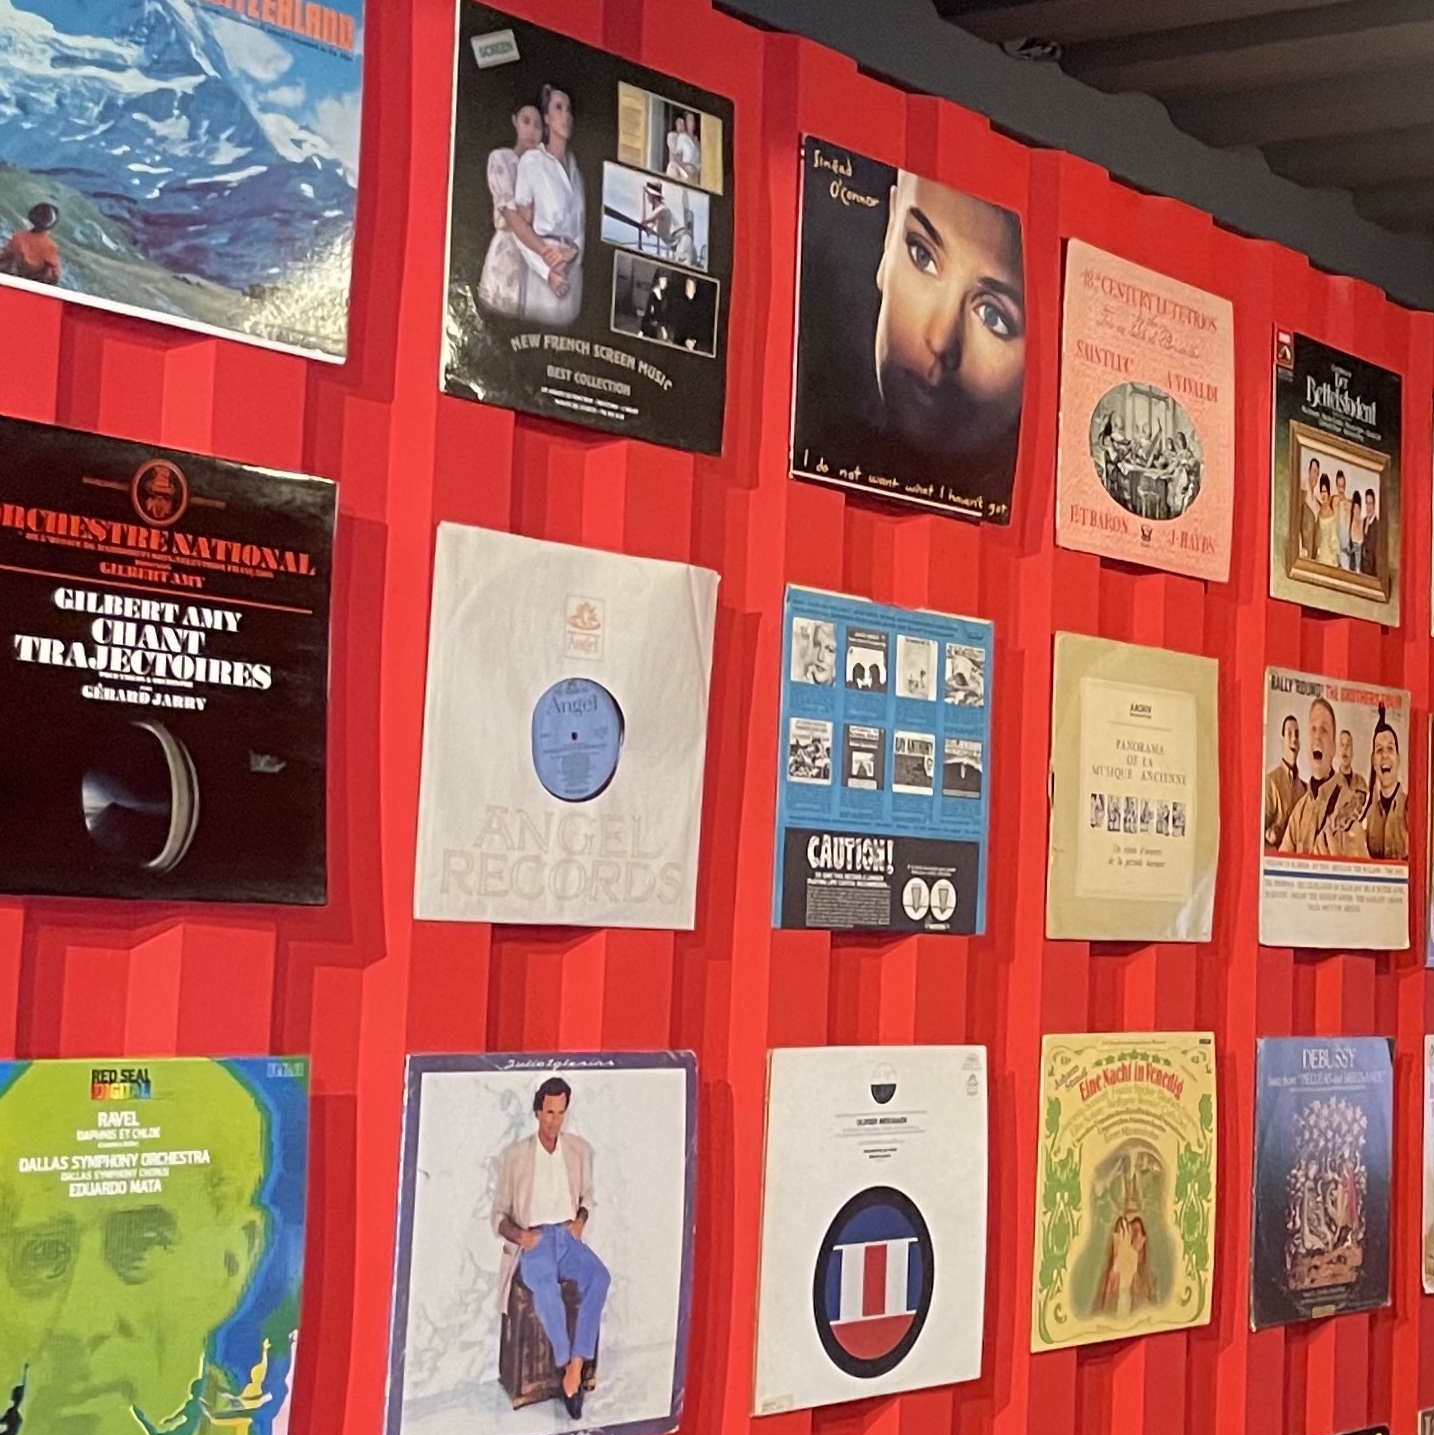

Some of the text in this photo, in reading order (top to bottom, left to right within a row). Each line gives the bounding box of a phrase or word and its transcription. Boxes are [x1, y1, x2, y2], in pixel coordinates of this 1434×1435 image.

[511, 333, 673, 391] NEW FRENCH SCREEN MUSIC
[547, 365, 632, 397] BEST COLLECTION
[816, 457, 829, 473] do
[839, 466, 862, 482] not
[868, 476, 899, 489] want
[905, 483, 934, 500] what
[988, 504, 1008, 517] got
[0, 503, 168, 551] RCHESTRE
[172, 530, 316, 577] NATIONAL
[100, 561, 168, 584] GILBERT
[170, 571, 206, 588] AMY
[54, 587, 243, 633] GILBERT AMY
[91, 617, 206, 655] CHANT
[13, 634, 273, 690] TRAJECTOIRES
[152, 692, 207, 712] JARRY
[549, 694, 598, 717] Angel
[1115, 739, 1165, 755] PANORAMA
[1091, 764, 1133, 781] MUSIQUE
[473, 803, 664, 860] ANGEL
[807, 834, 895, 875] CAUTION!
[439, 847, 684, 906] RECORDS
[1301, 1047, 1356, 1070] DEBUSSY
[91, 1067, 151, 1084] RED SEAL
[1079, 1072, 1102, 1102] Eine
[1102, 1061, 1133, 1087] Nacht
[1134, 1060, 1145, 1082] in
[1146, 1061, 1184, 1101] Venedig
[97, 1110, 140, 1127] RAVEL
[19, 1150, 210, 1173] DALLAS SYMPHONY ORCHESTRA
[69, 1178, 162, 1198] EDUARDO MATA
